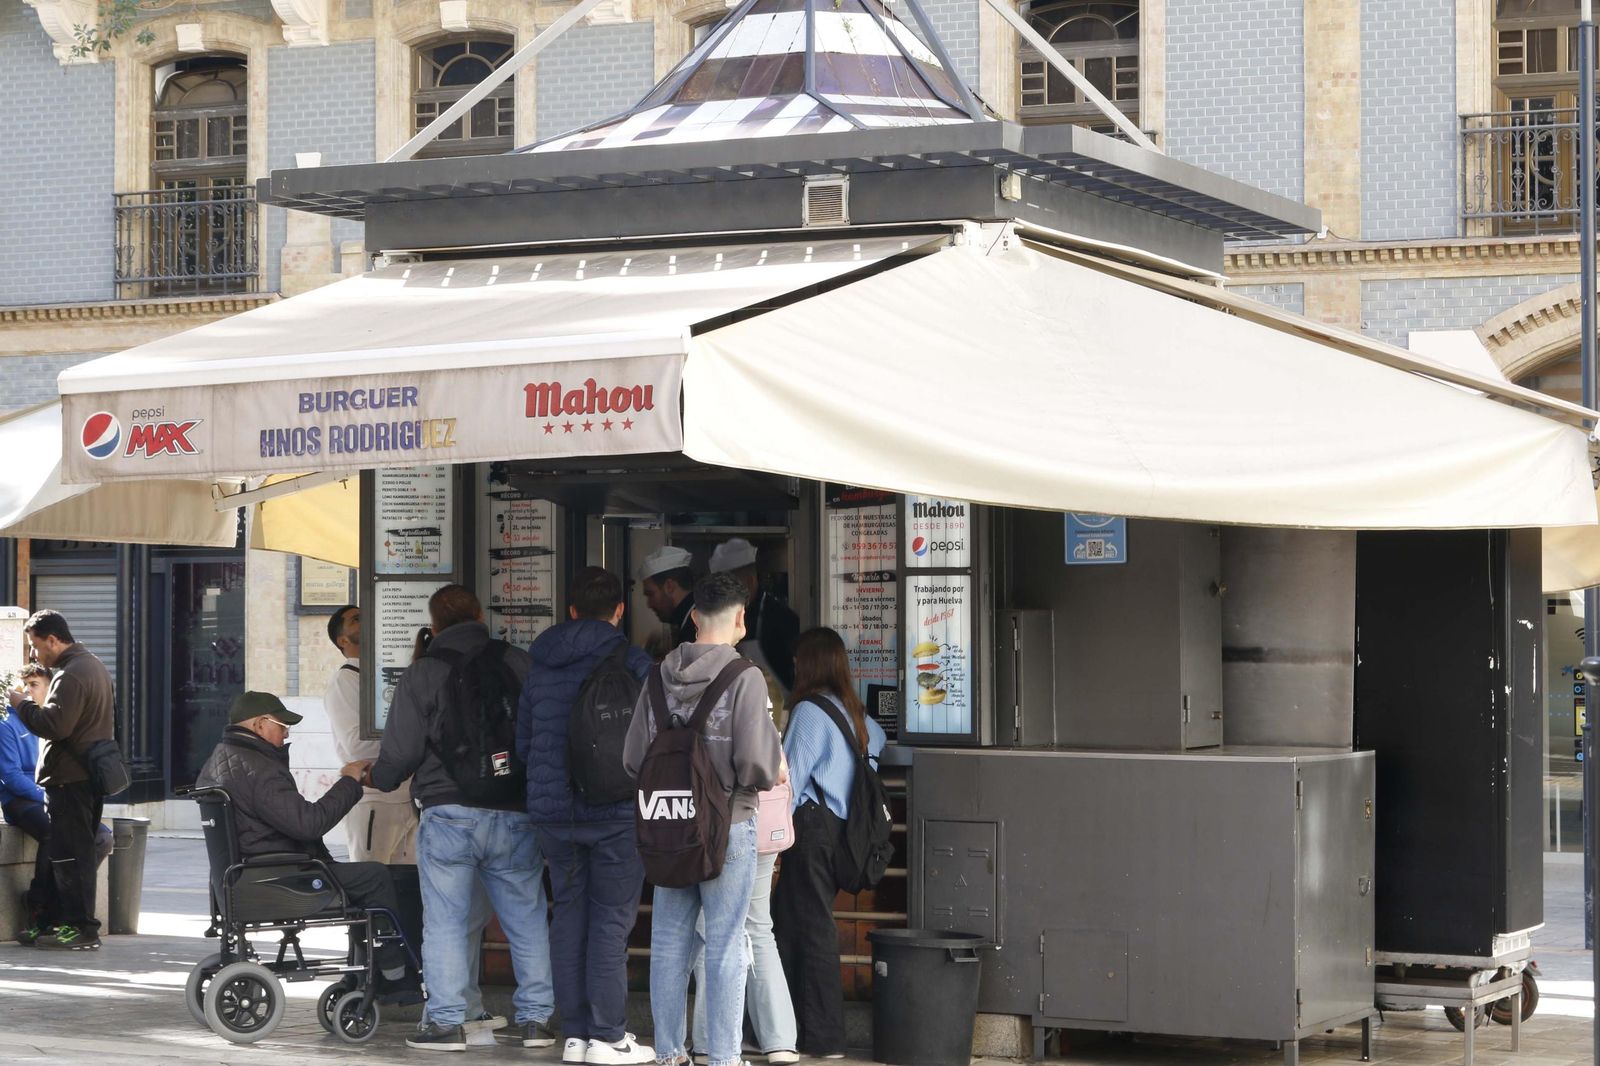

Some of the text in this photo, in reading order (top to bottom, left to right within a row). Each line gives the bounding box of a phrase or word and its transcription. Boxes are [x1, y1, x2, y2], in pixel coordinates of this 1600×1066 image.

[298, 386, 418, 414] BURGUER
[524, 378, 654, 418] Mahou
[132, 406, 164, 420] pepsi
[123, 419, 204, 460] MAX
[260, 417, 457, 458] HNOS RODRIGUEZ
[913, 501, 965, 518] Mahou
[930, 538, 964, 554] pepsi
[914, 585, 951, 594] Trabajando
[917, 598, 921, 606] y
[601, 708, 632, 720] AIR
[638, 789, 696, 820] VANS
